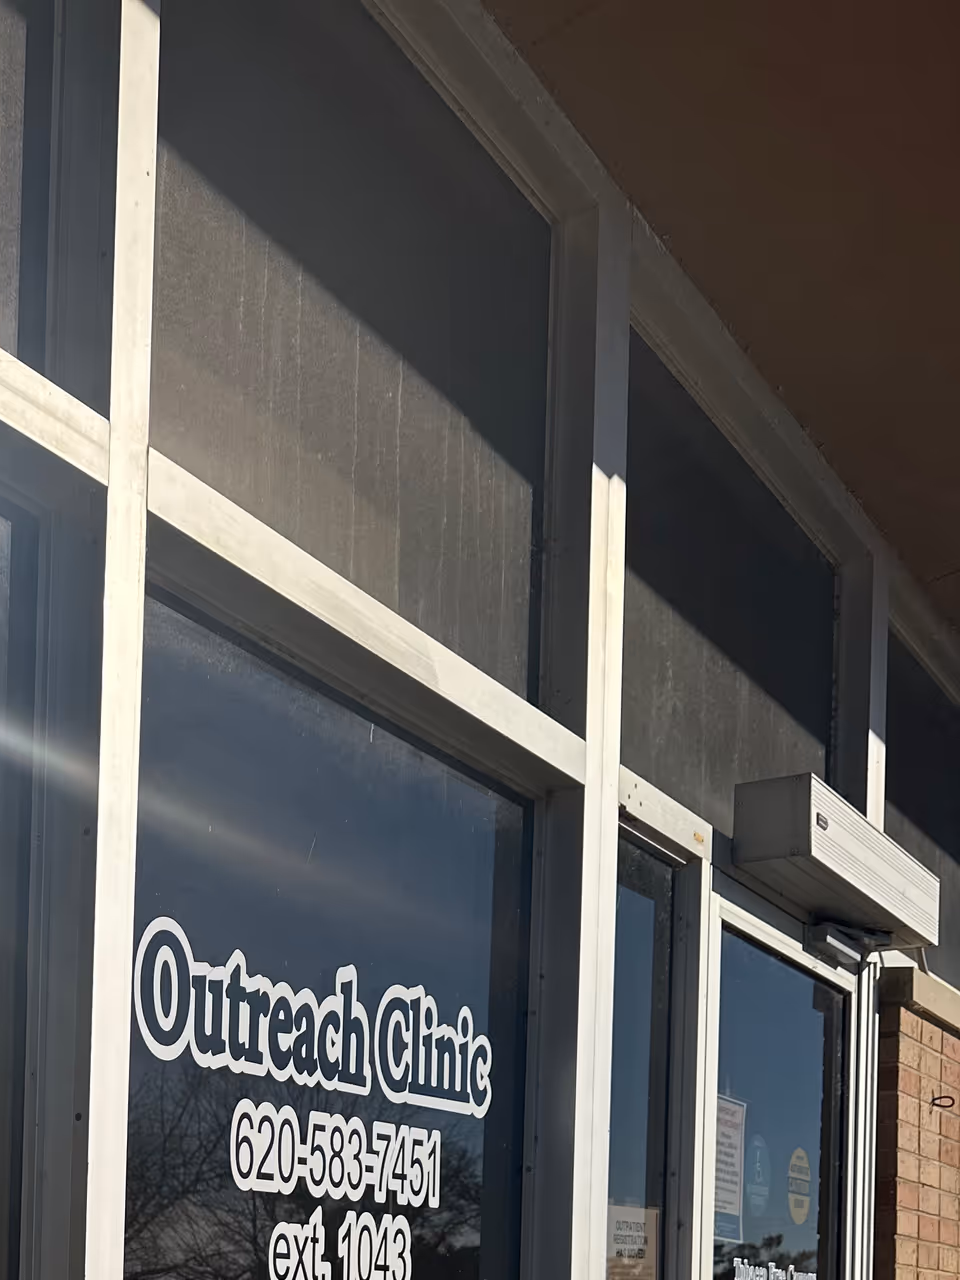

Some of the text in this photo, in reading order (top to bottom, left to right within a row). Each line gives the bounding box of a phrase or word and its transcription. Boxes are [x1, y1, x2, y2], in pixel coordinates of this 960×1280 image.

[135, 916, 493, 1119] Outreach Clinic
[230, 1098, 441, 1209] 620-583-7451
